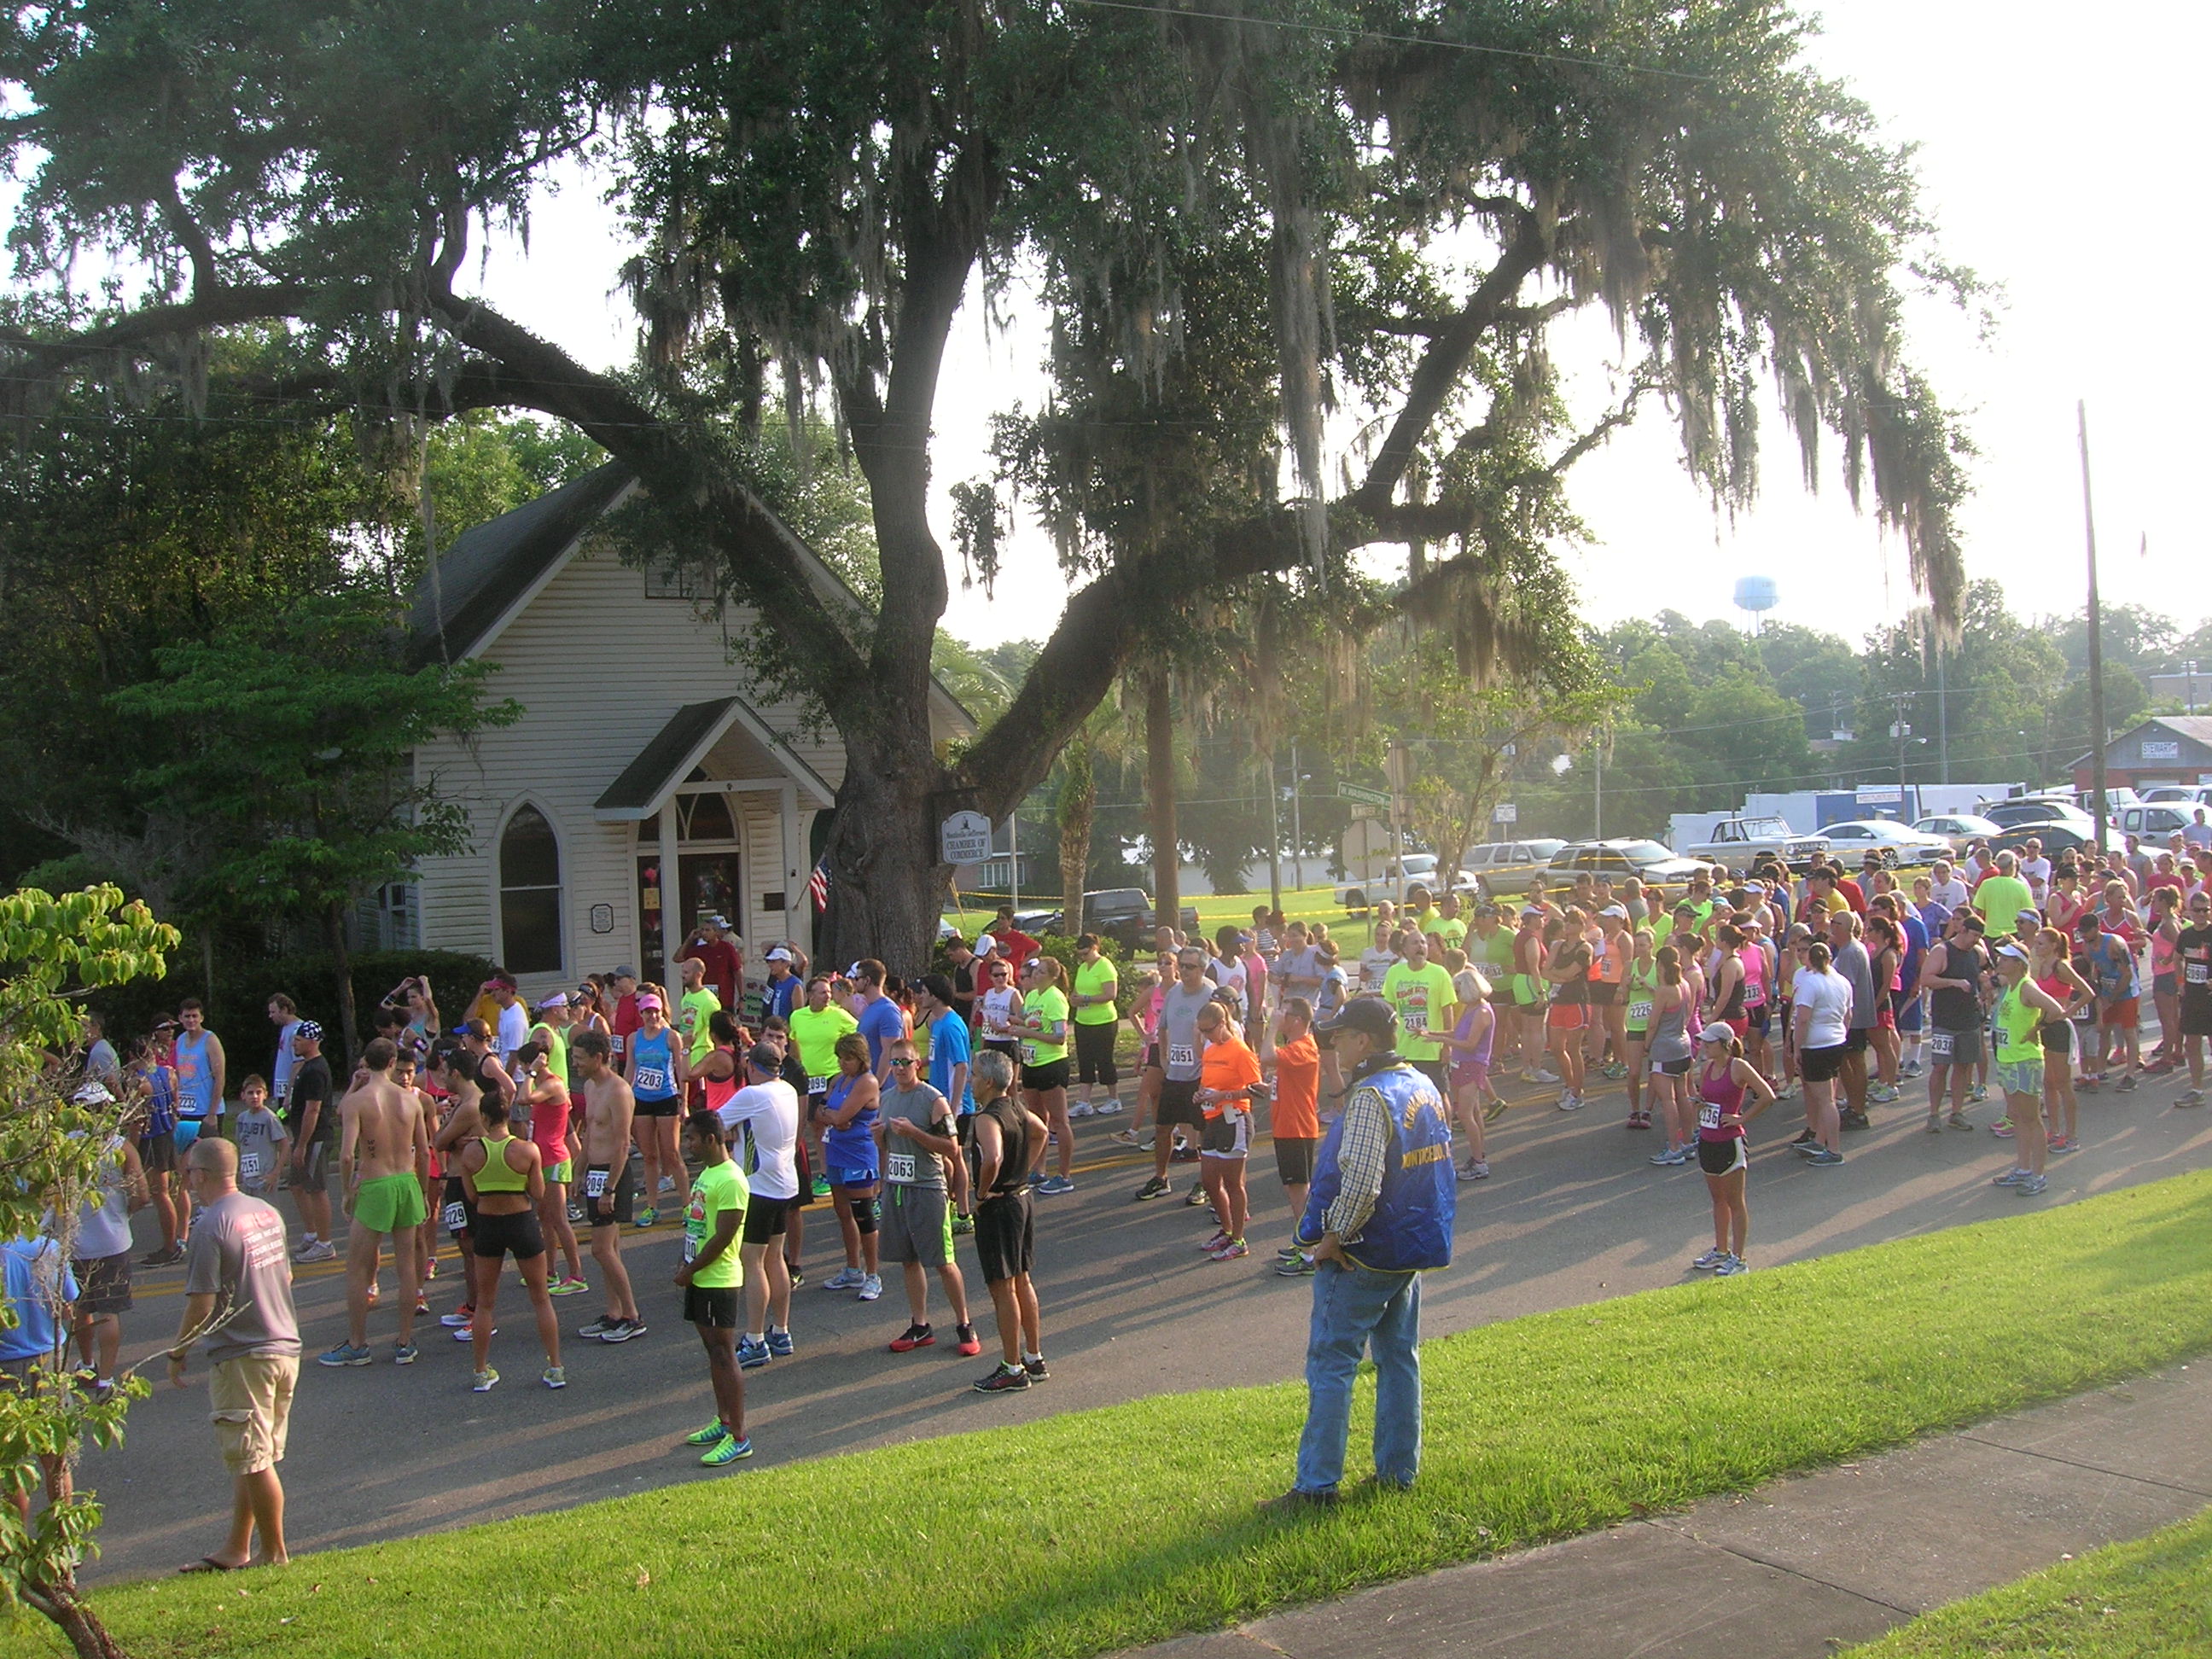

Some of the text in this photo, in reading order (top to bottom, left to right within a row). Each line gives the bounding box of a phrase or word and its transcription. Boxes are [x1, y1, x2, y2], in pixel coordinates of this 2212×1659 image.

[946, 838, 986, 851] CHAMBER OF
[950, 849, 983, 860] COMMERCE
[1171, 1050, 1192, 1062] 2051
[638, 1072, 662, 1088] 2203
[889, 1161, 913, 1178] 2063
